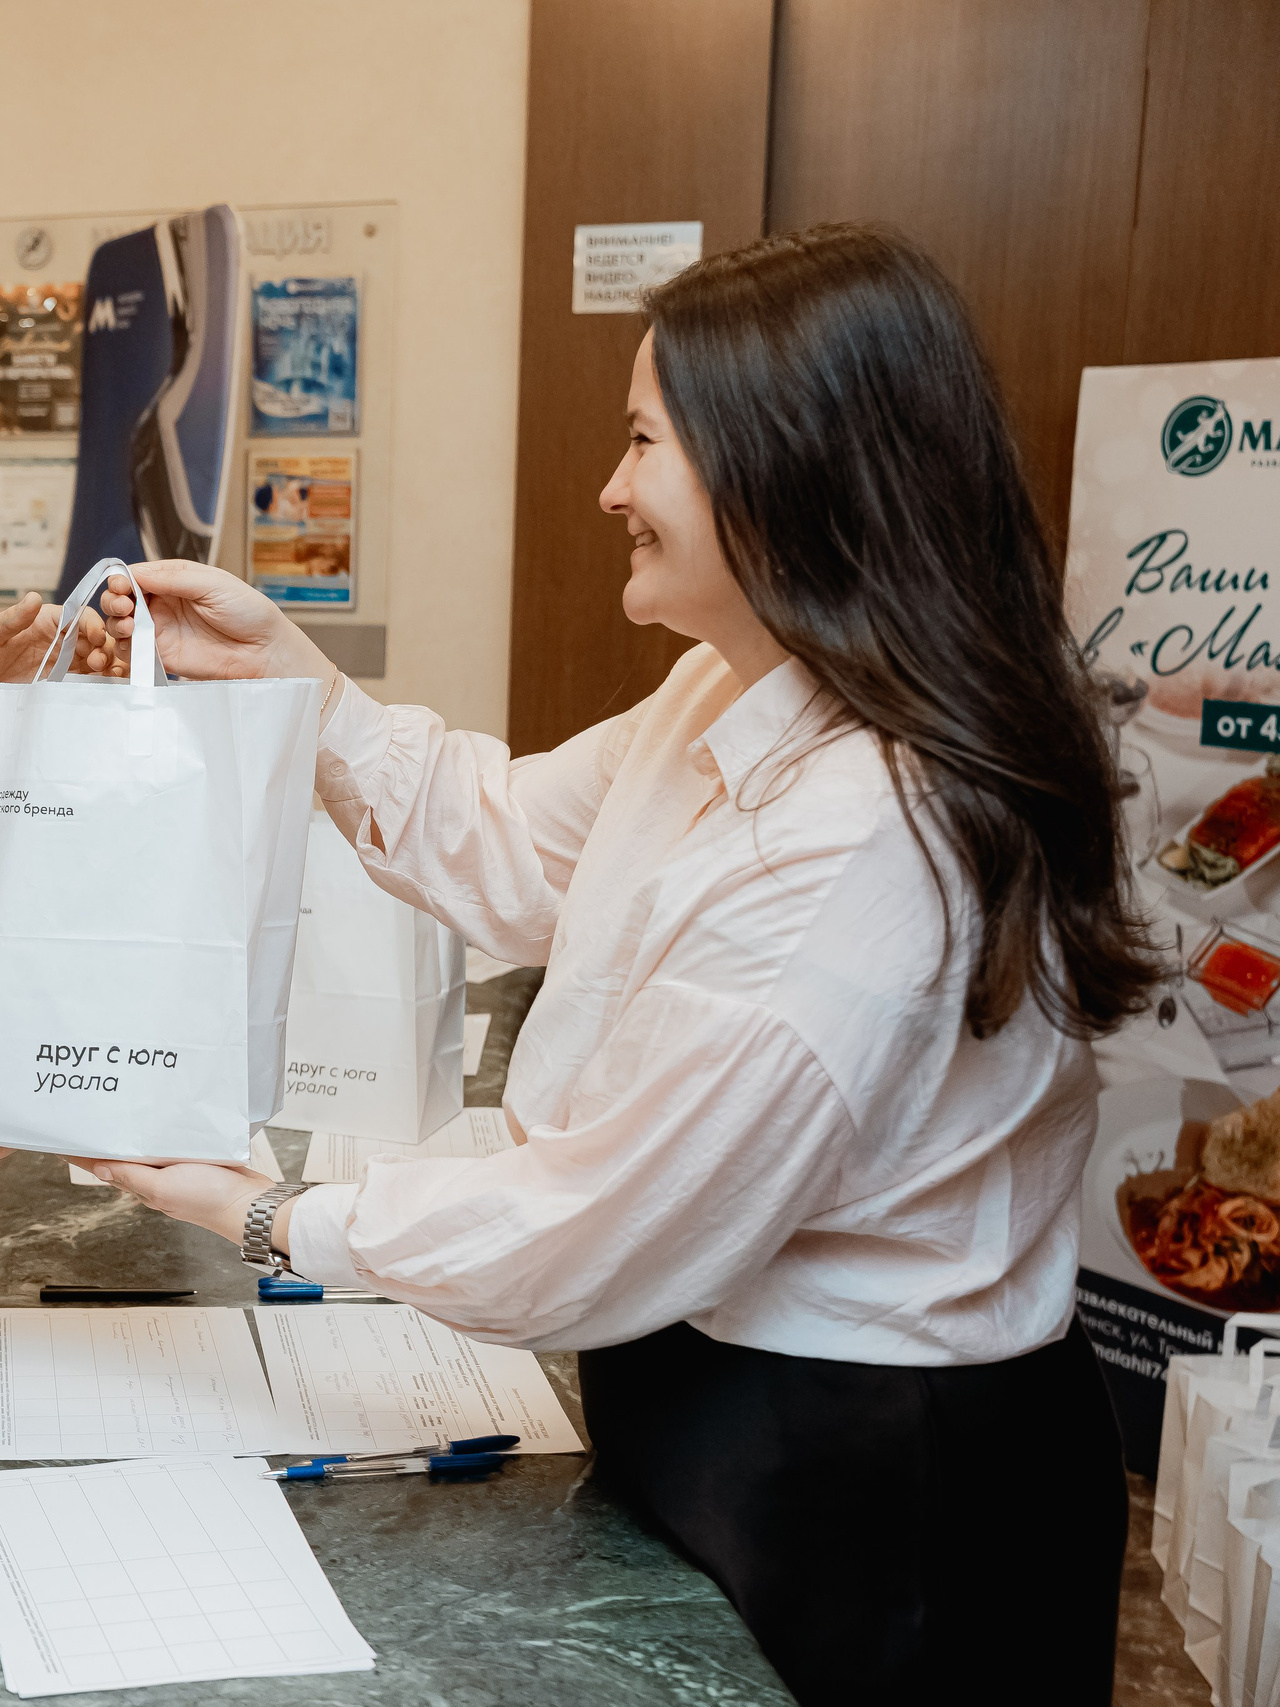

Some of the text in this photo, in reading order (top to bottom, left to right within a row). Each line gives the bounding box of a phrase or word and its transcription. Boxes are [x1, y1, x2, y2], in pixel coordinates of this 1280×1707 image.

[1239, 420, 1280, 452] М
[1126, 528, 1269, 596] Ваши
[1130, 603, 1280, 676] «Ма
[1260, 714, 1280, 742] 4
[23, 802, 74, 817] бренда
[36, 1041, 179, 1069] друг с юга
[34, 1069, 120, 1094] урала
[288, 1061, 377, 1081] друг с юга
[285, 1078, 338, 1096] урала
